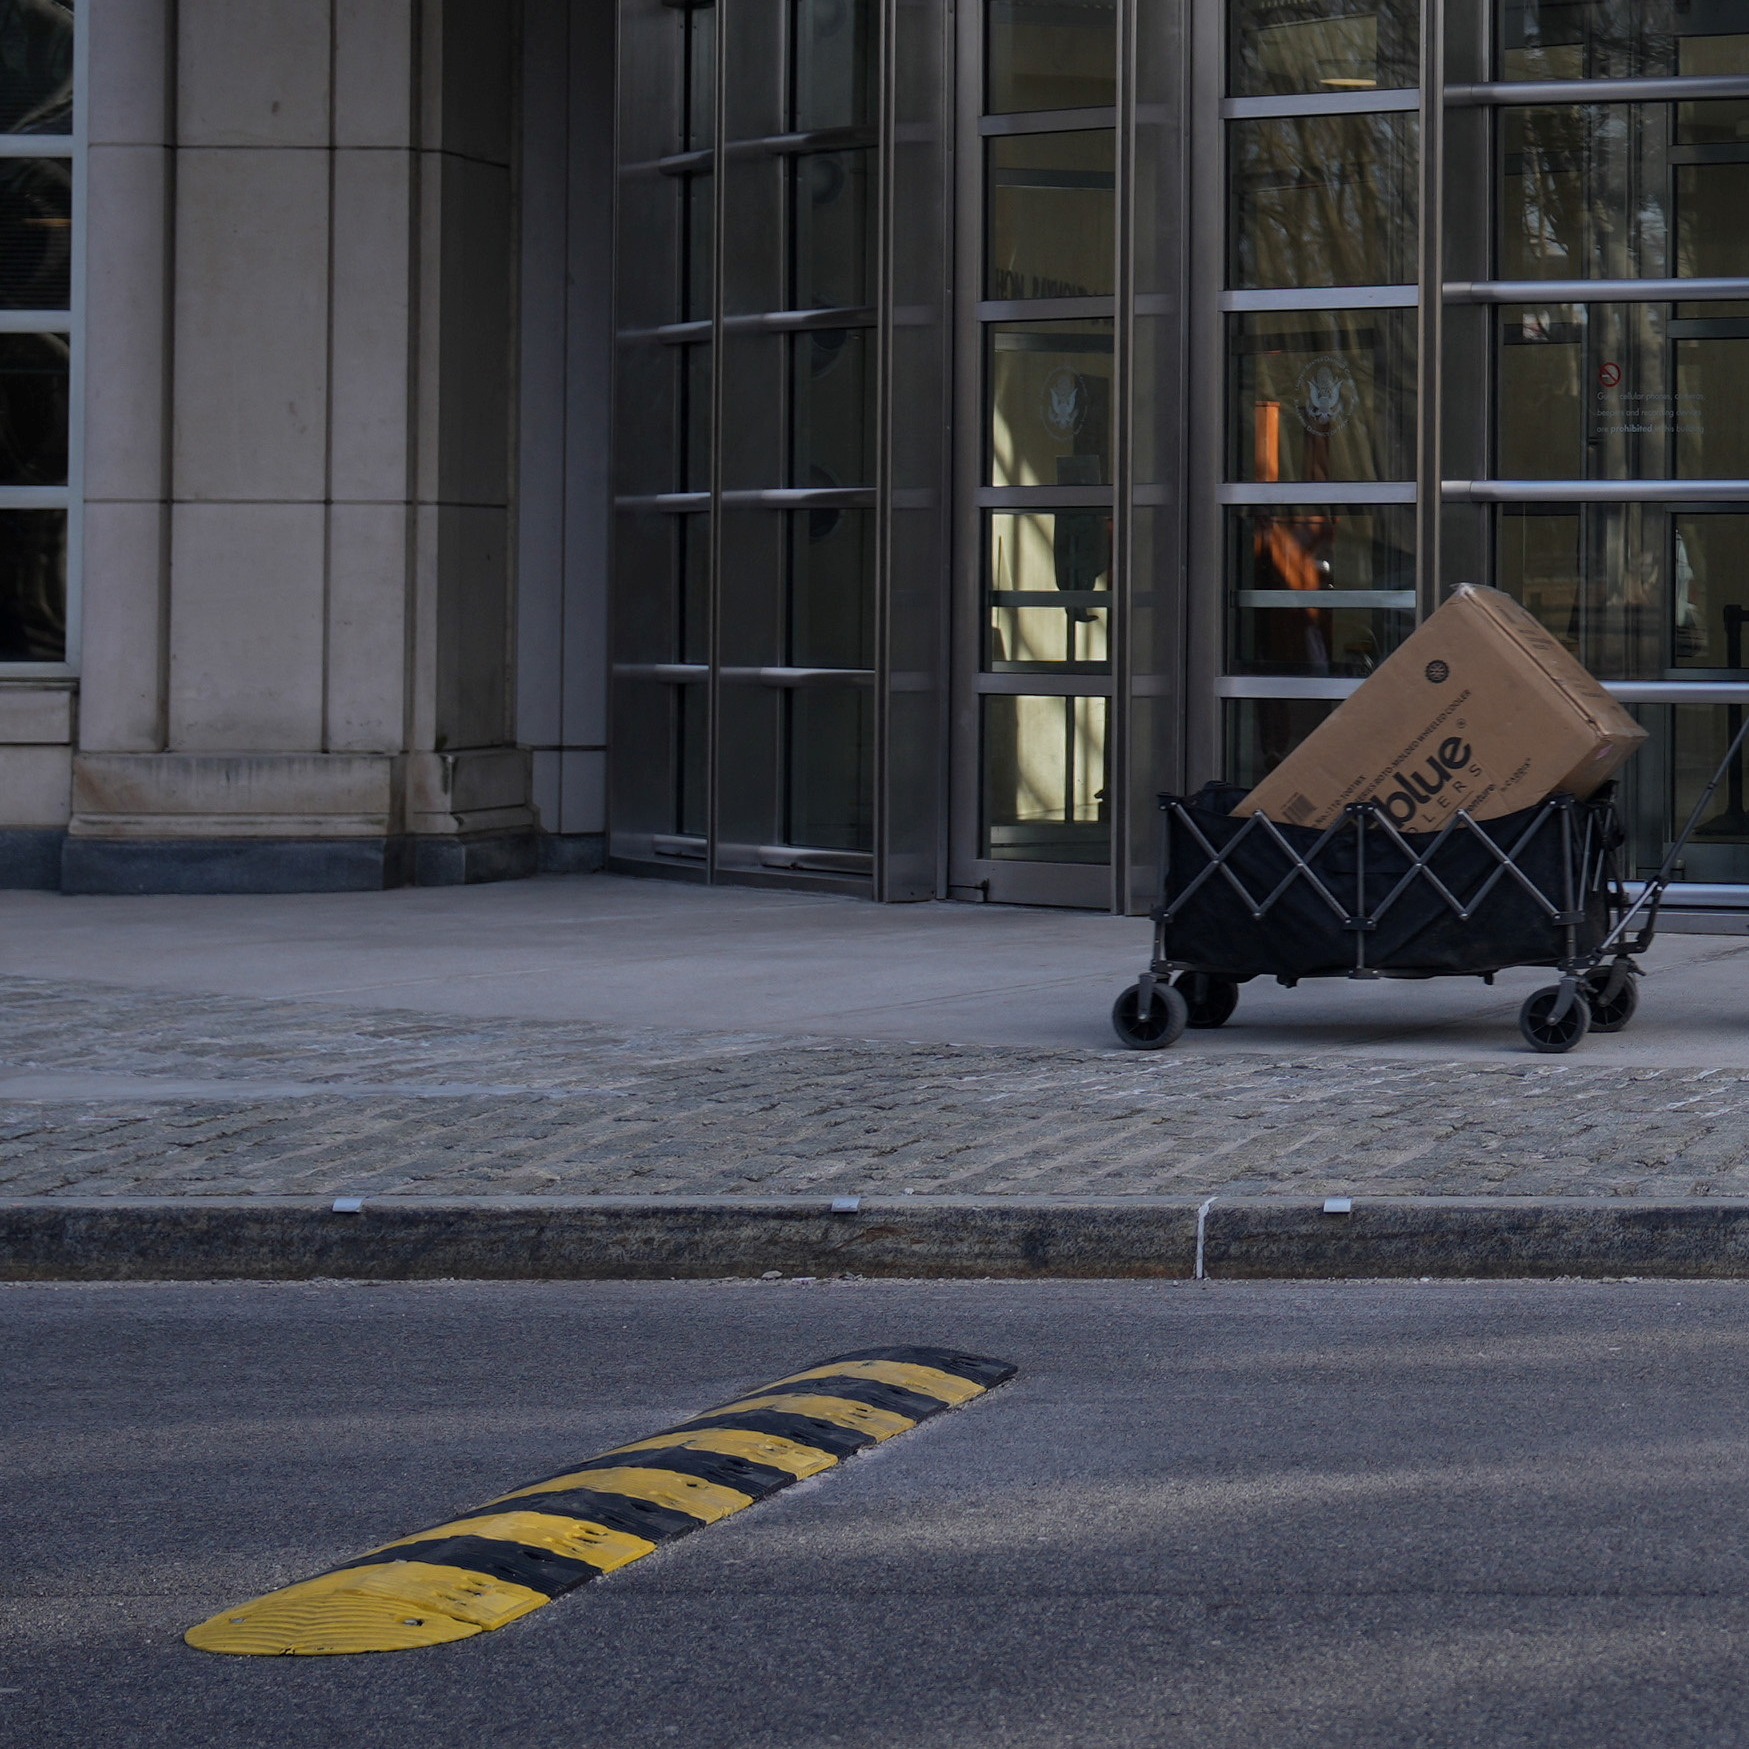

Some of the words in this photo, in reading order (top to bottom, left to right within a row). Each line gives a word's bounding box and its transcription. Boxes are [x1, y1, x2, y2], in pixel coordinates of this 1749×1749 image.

[1610, 424, 1652, 434] prohibited
[1446, 689, 1472, 715] COOLER
[1370, 736, 1472, 828] blue
